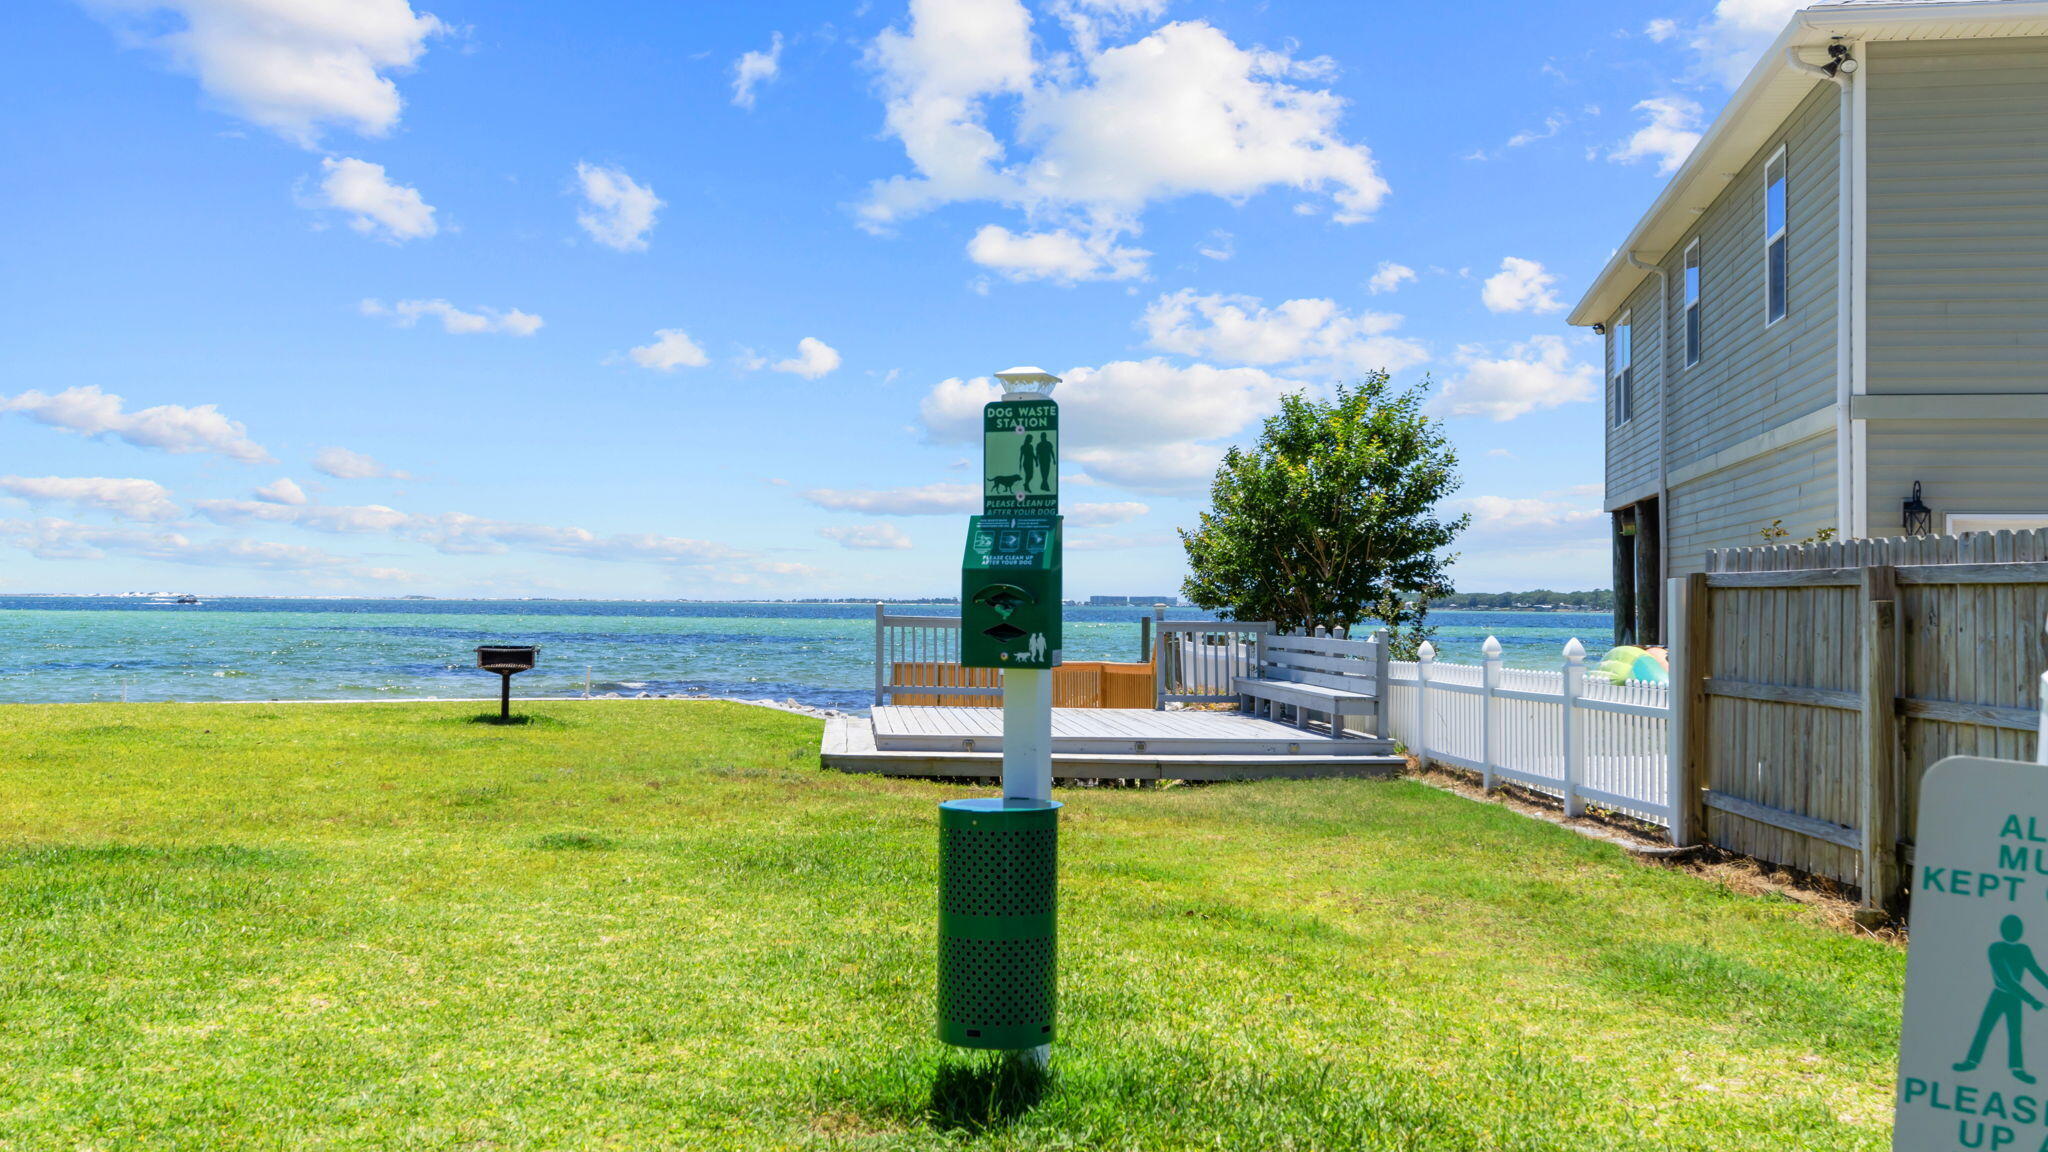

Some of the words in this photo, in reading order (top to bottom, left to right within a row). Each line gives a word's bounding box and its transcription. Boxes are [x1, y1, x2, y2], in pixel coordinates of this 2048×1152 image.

[987, 408, 1013, 418] DOG
[1018, 406, 1057, 417] WASTE
[996, 418, 1048, 428] STATION
[986, 500, 1015, 508] PLEASE
[1045, 499, 1057, 507] UP
[1999, 814, 2048, 843] AL
[1922, 866, 2026, 902] KEPT
[1904, 1077, 2048, 1128] PLEAS
[1958, 1119, 2016, 1152] UP
